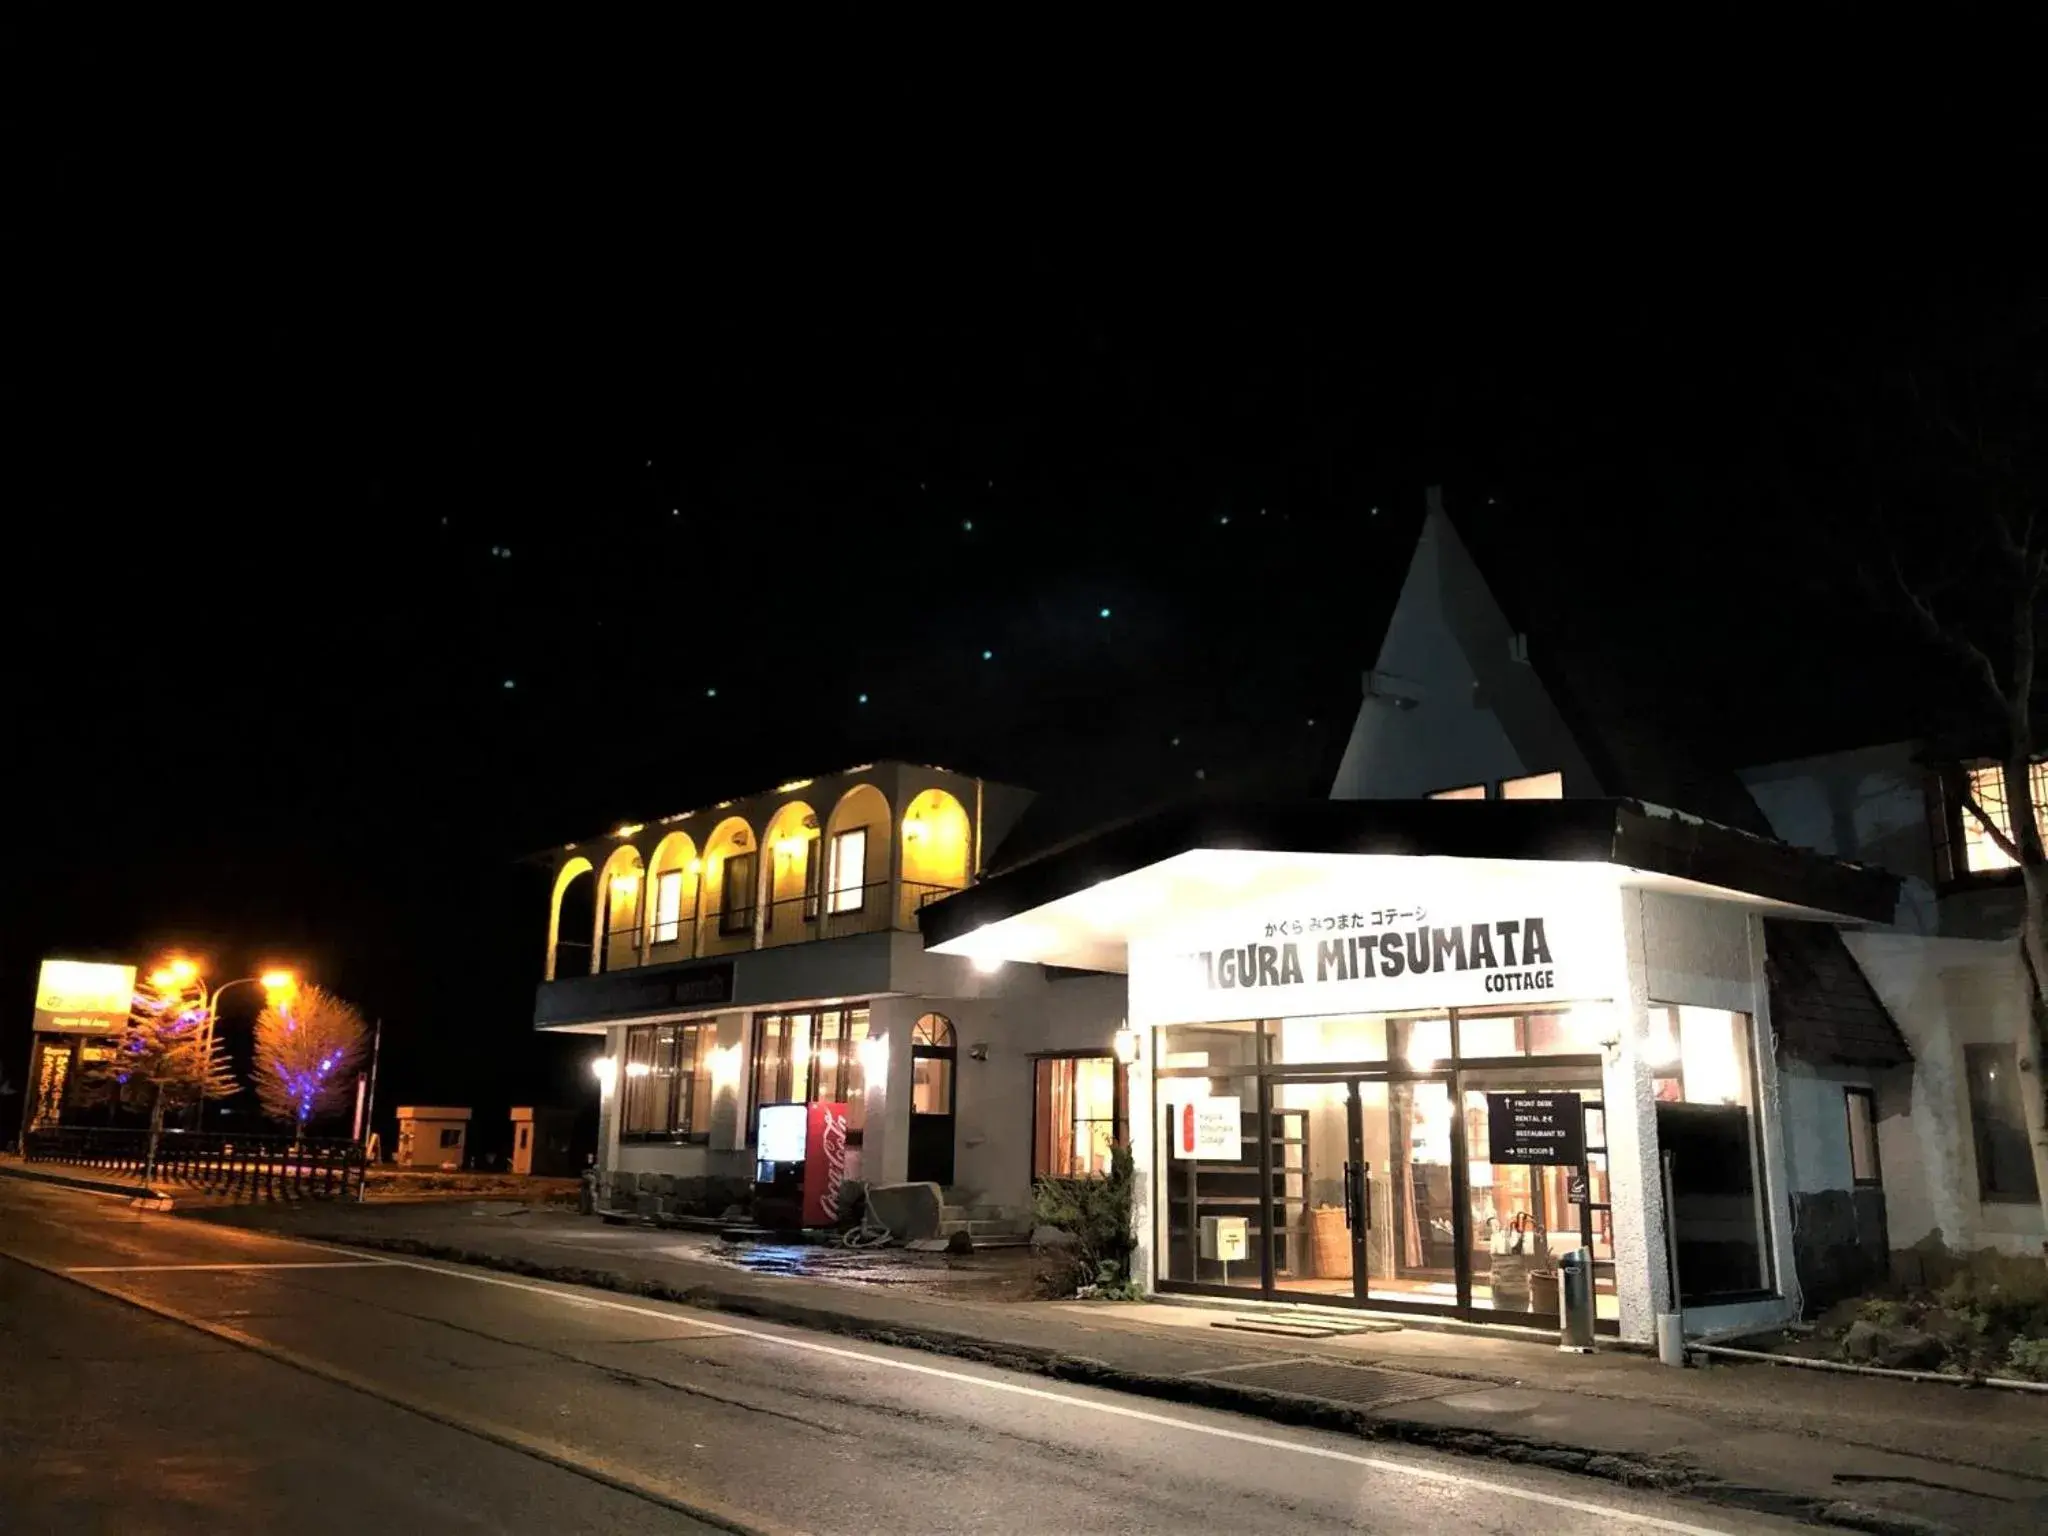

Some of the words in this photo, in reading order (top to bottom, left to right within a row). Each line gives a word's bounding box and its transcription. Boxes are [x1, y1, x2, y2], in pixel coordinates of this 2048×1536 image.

[1309, 912, 1365, 932] みつまた
[1316, 917, 1554, 983] MITSUMATA
[1485, 970, 1555, 993] COTTAGE
